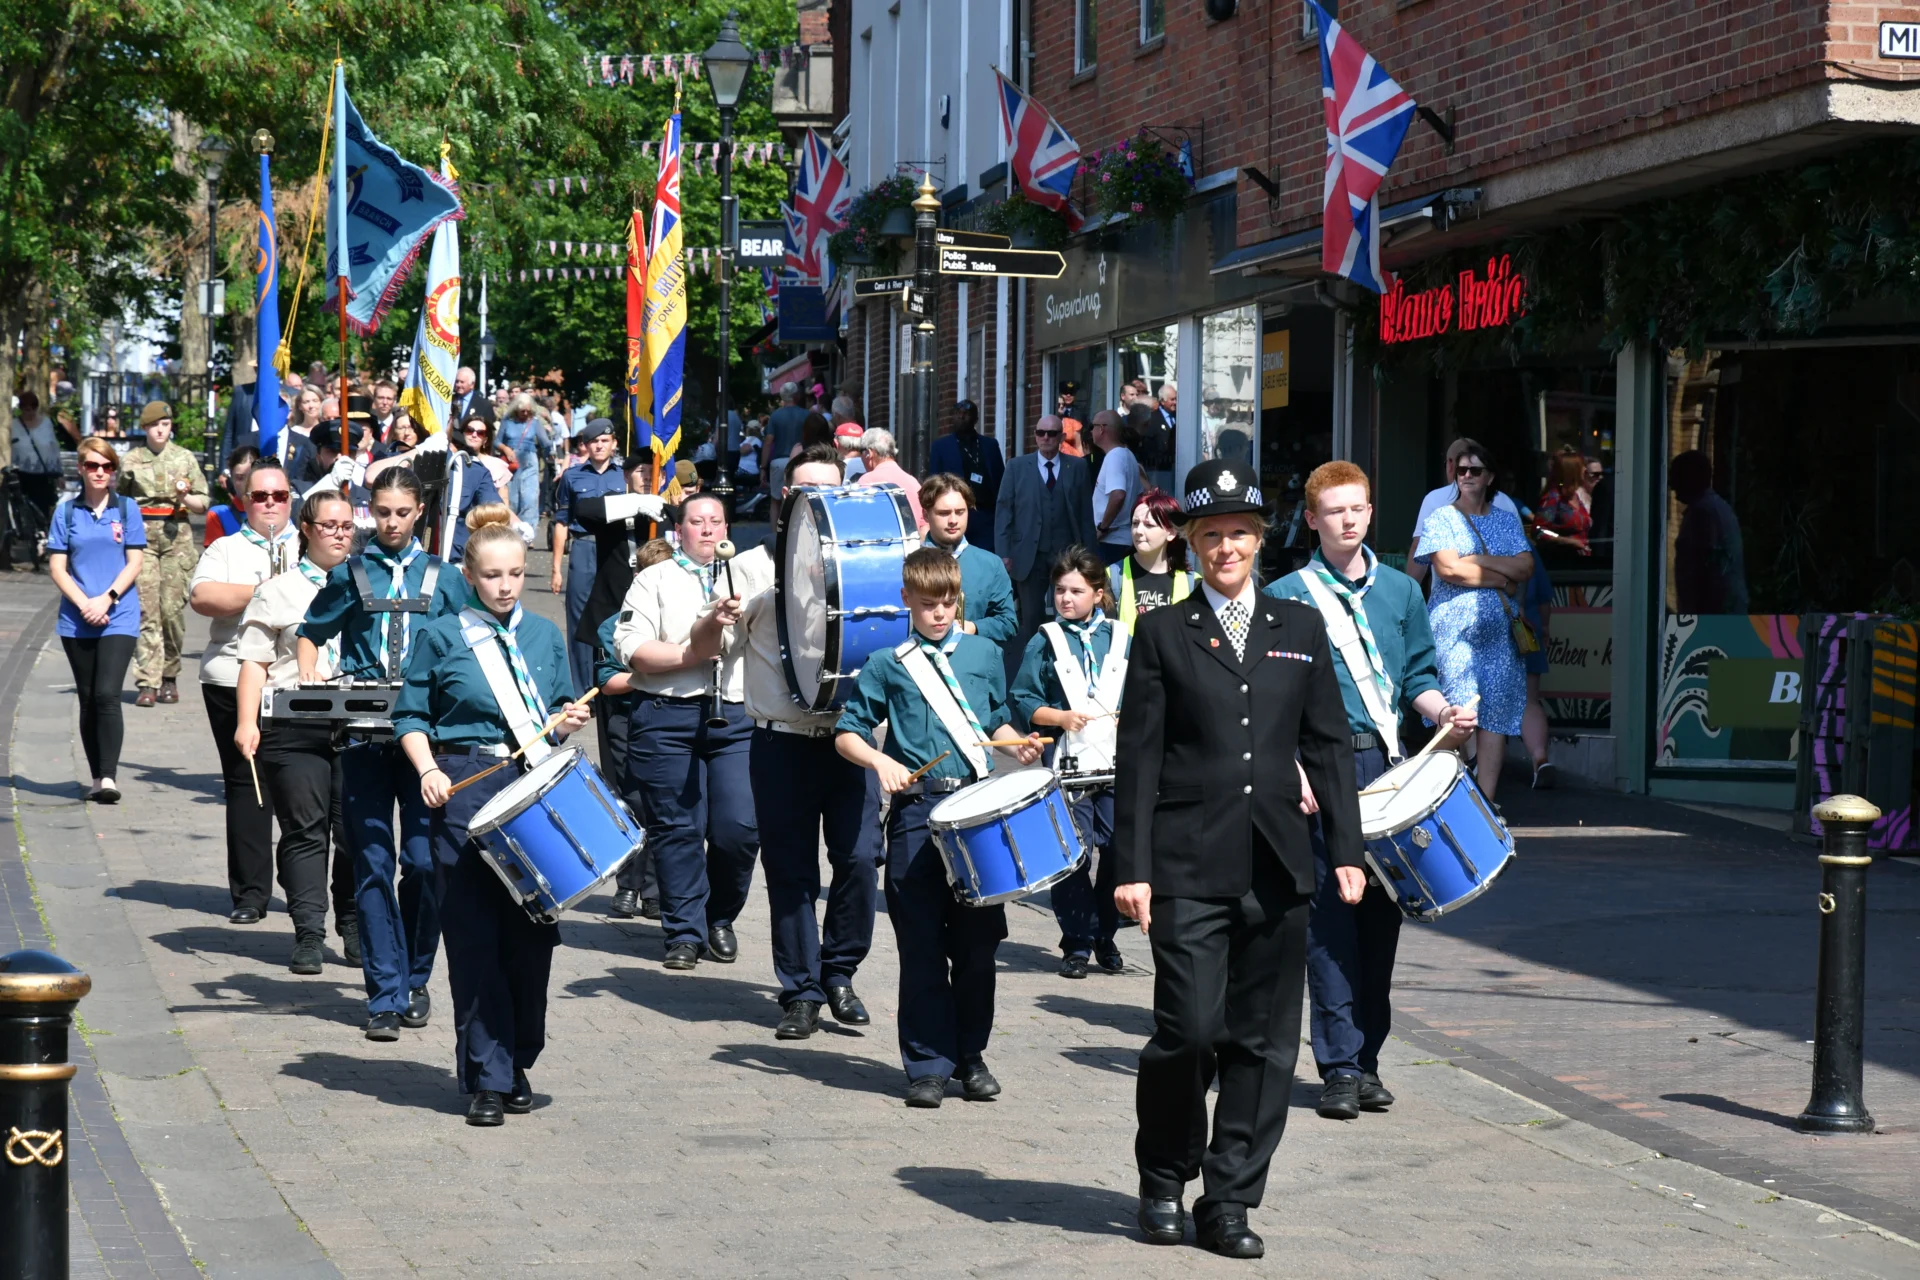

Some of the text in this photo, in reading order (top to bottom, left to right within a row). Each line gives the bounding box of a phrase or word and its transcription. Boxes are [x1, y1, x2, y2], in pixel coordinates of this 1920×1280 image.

[358, 203, 393, 230] BRANCH
[740, 238, 784, 257] BEAR
[937, 232, 955, 245] Library
[943, 250, 967, 261] Police
[942, 260, 997, 272] Public Toilets
[649, 299, 678, 335] STONE
[1046, 288, 1101, 328] Superdrug
